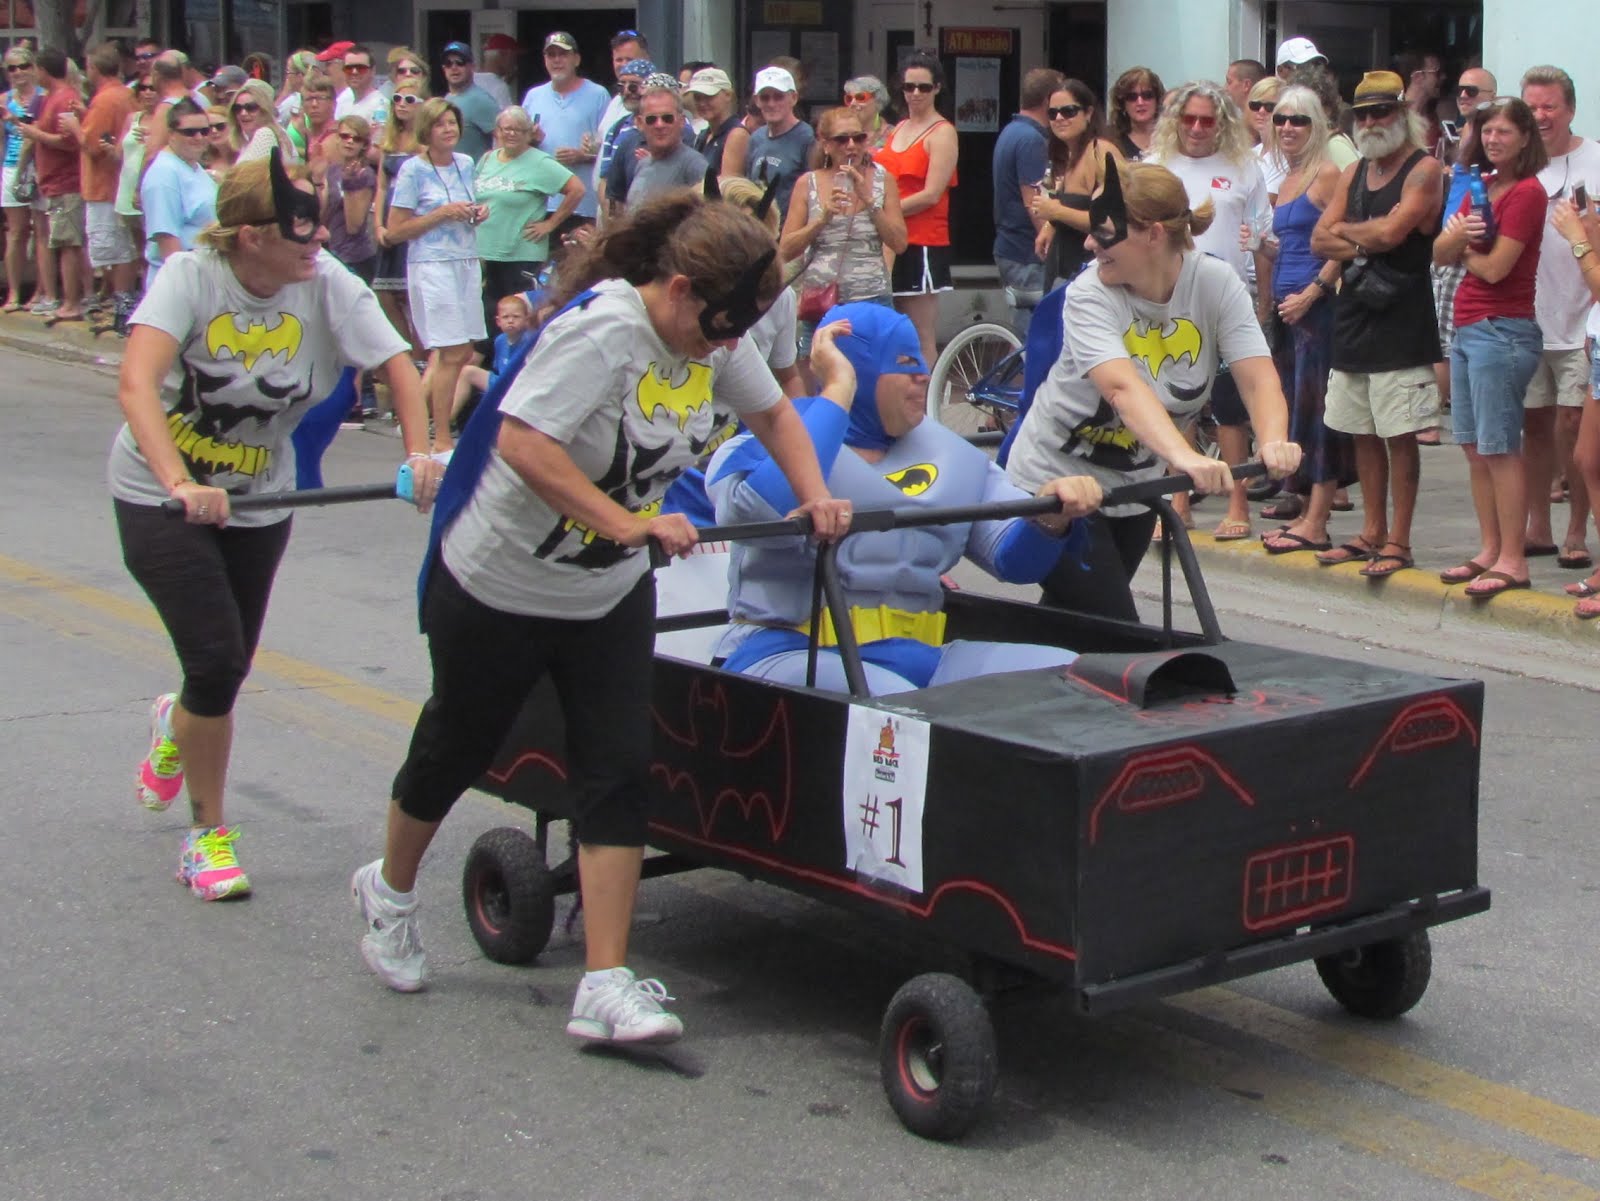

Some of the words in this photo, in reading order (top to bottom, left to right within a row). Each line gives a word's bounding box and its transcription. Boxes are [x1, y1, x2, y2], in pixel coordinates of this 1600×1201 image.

[949, 32, 972, 49] ATM
[976, 32, 1008, 49] inside
[859, 793, 907, 869] #1
